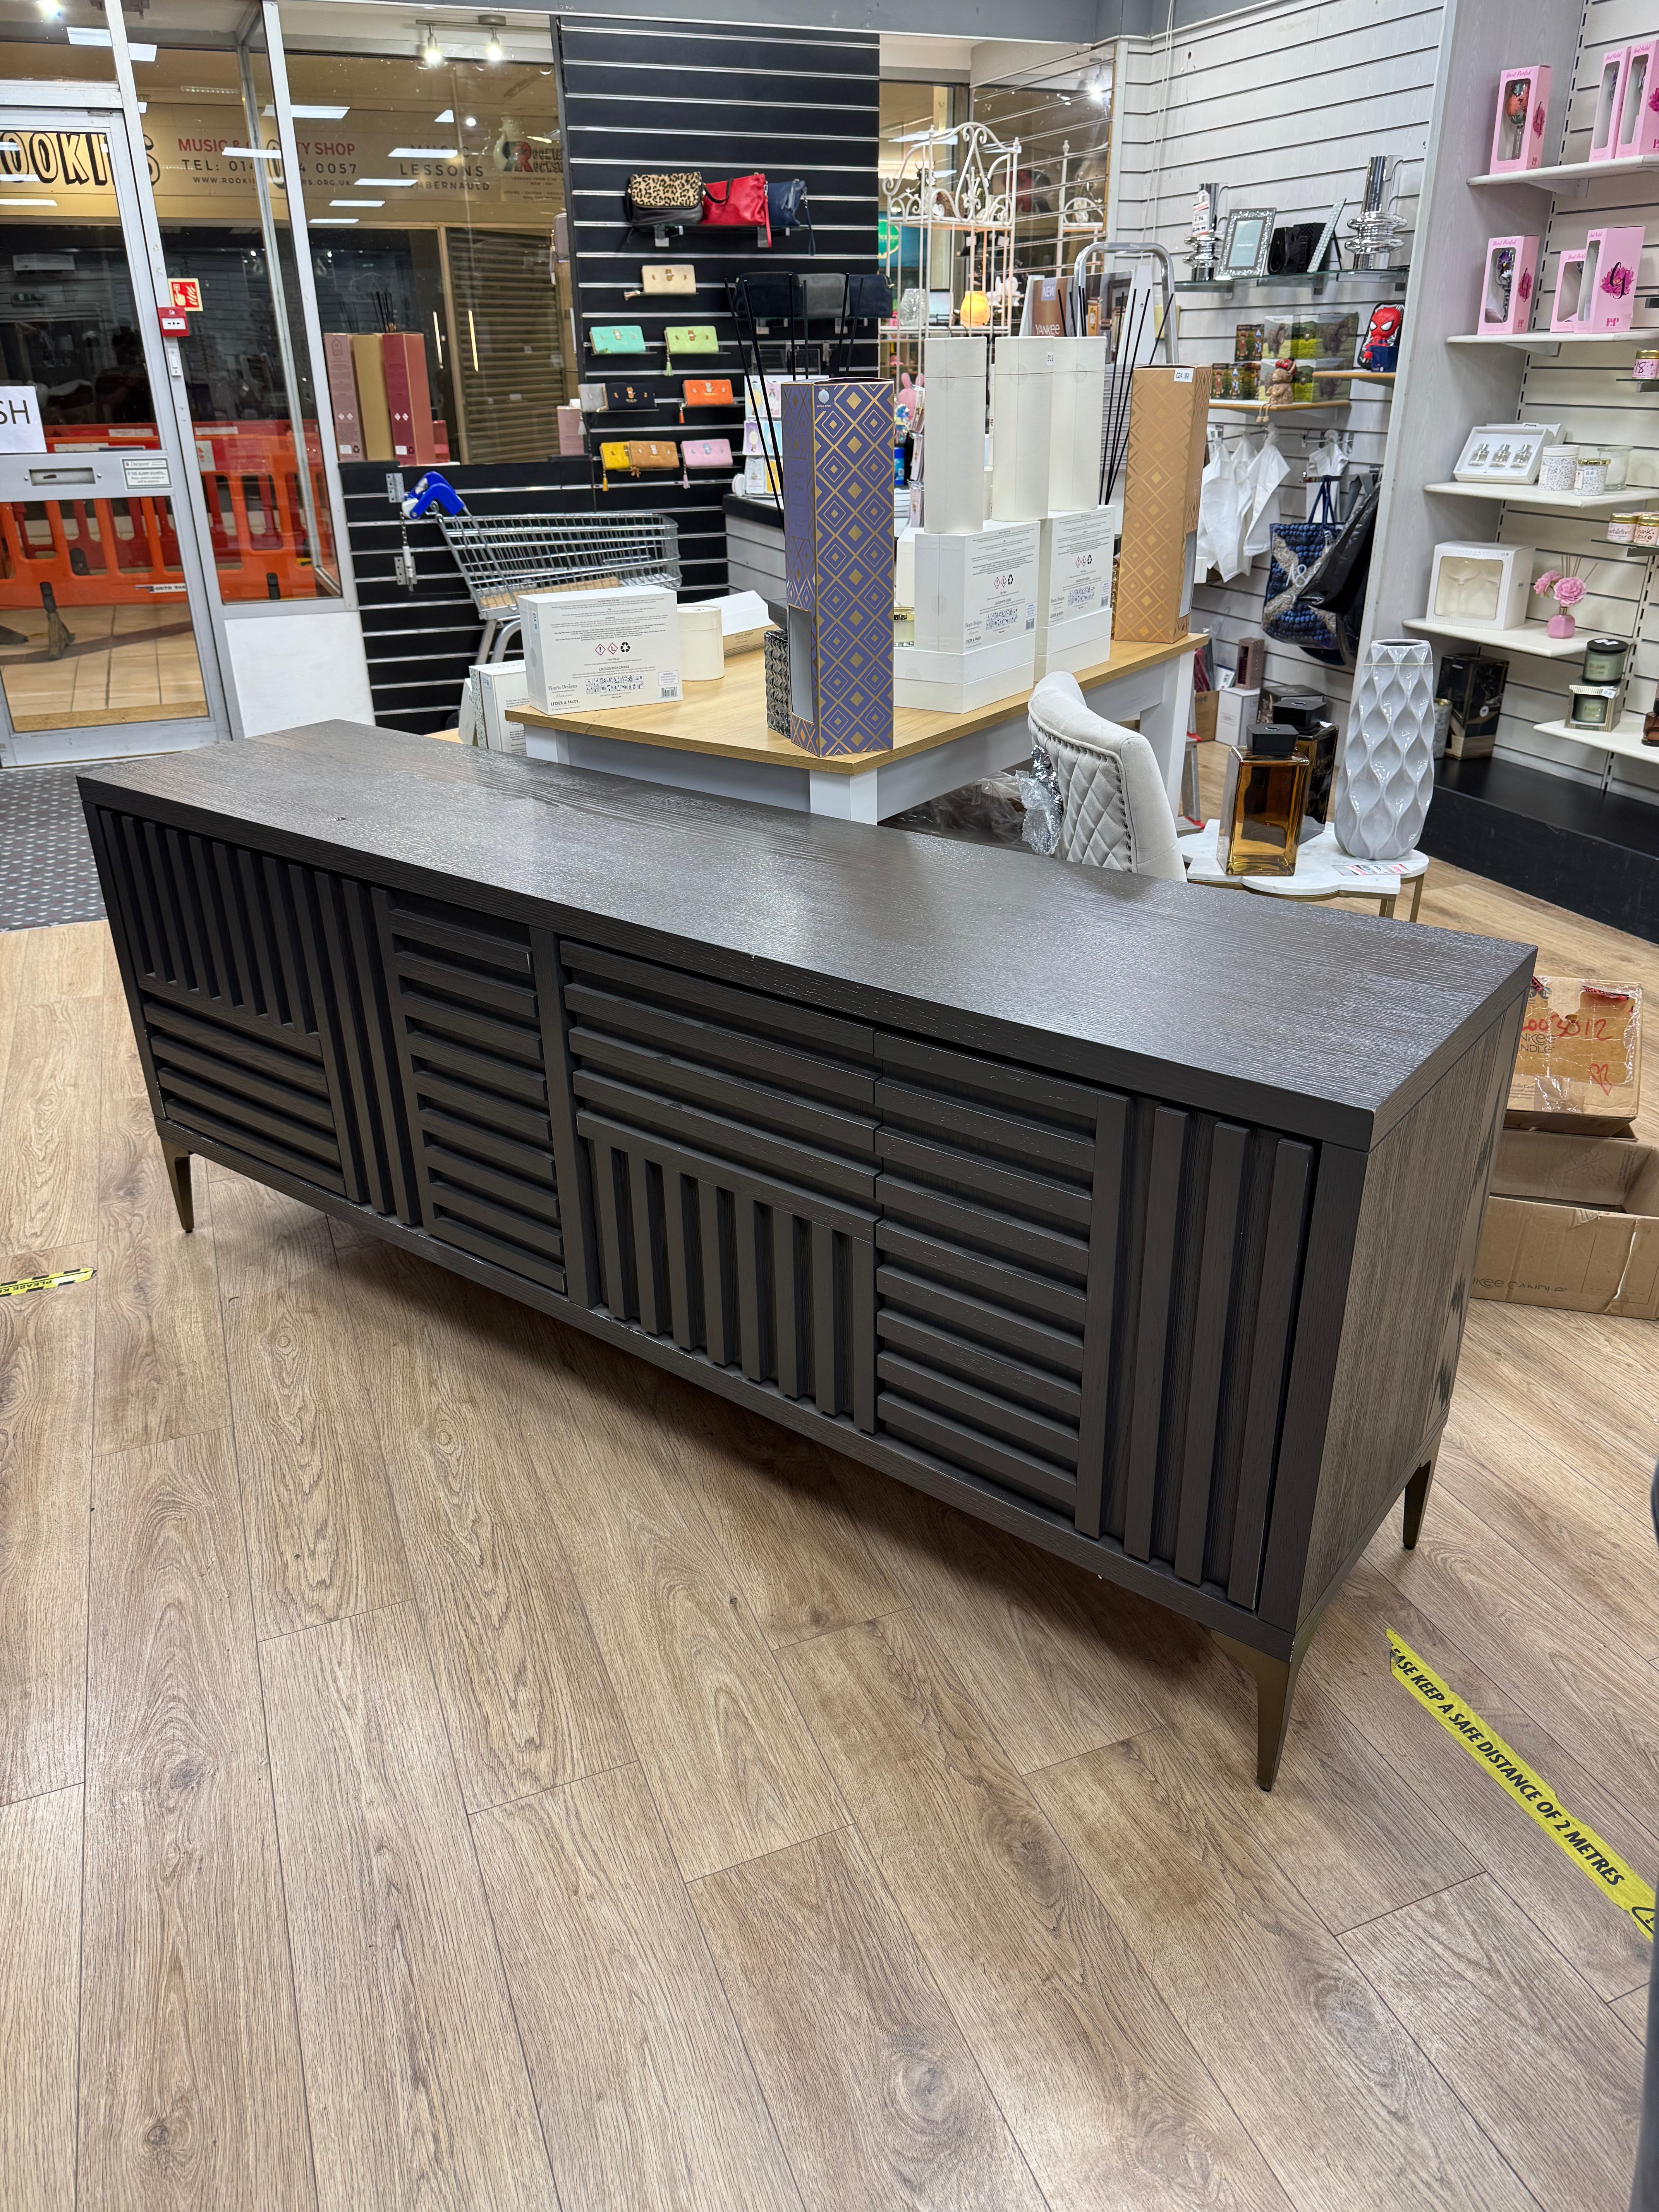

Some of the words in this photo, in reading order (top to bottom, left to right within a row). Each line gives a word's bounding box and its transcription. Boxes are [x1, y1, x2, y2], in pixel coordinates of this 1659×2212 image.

[315, 143, 356, 156] SHOP
[182, 160, 219, 171] TEL:
[316, 163, 357, 174] 0057
[400, 164, 483, 176] LESSONS
[400, 181, 490, 191] MBERNAULD
[1042, 286, 1056, 298] NEW
[1410, 1674, 1445, 1701] KEEP
[1437, 1704, 1455, 1714] A
[1449, 1713, 1485, 1743] SAFE
[1476, 1741, 1542, 1802] DISTANCE
[1536, 1802, 1563, 1819] OF
[1553, 1820, 1571, 1831] 2
[1564, 1831, 1625, 1886] METRES
